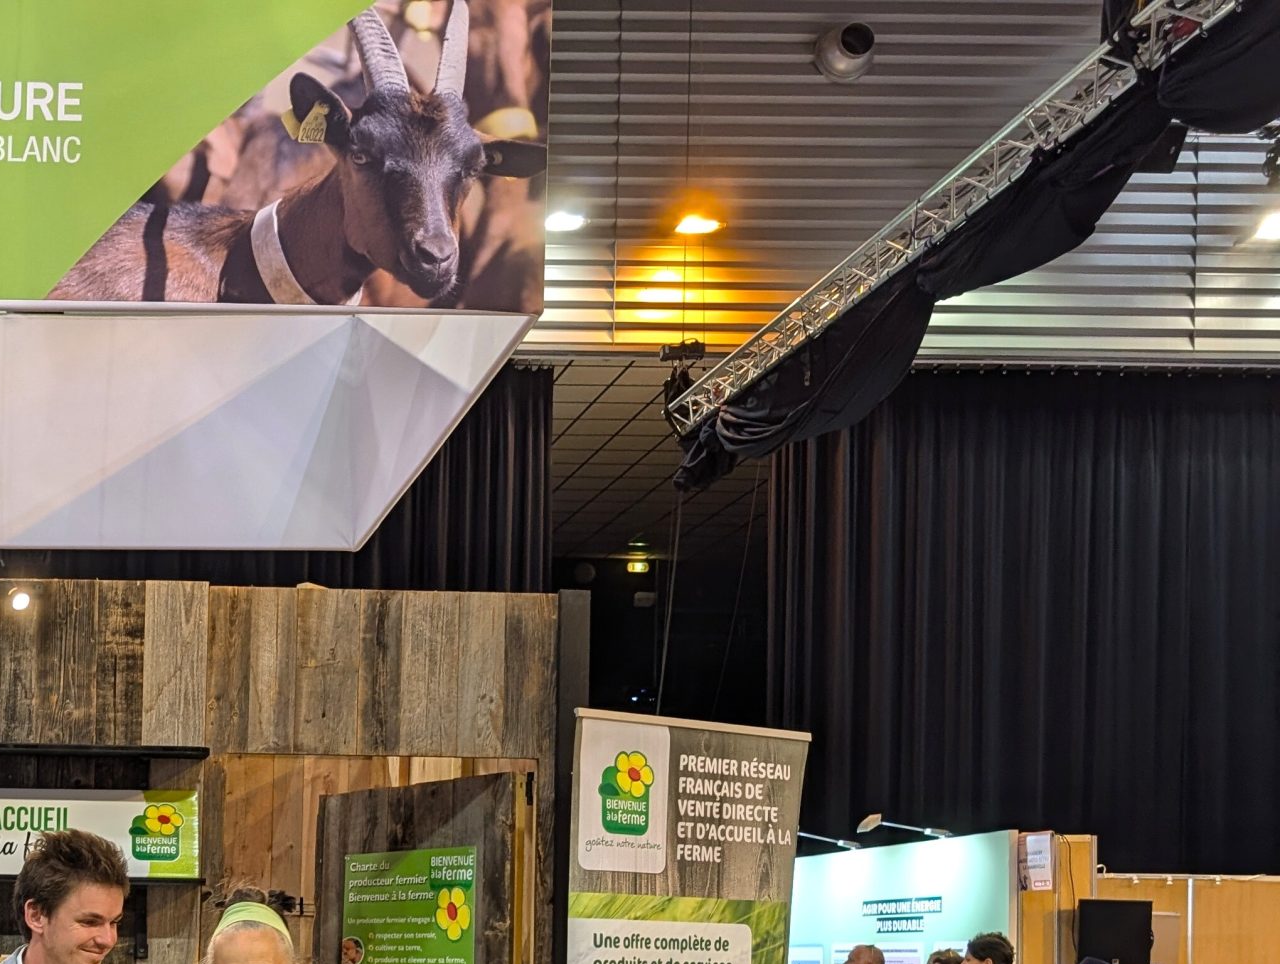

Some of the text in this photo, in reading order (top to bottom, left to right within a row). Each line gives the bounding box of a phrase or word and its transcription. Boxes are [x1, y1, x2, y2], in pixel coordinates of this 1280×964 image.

[679, 754, 791, 780] PREMIER RÉSEAU
[678, 777, 763, 801] FRANÇAIS DE
[607, 799, 646, 812] BIENVENUE
[678, 799, 778, 823] VENTE DIRECTE
[618, 812, 645, 825] ferme
[677, 822, 791, 845] ET D'ACCUEIL À LA
[136, 837, 177, 845] BIENVENUE
[585, 836, 662, 852] goûtez notre nature
[147, 844, 177, 855] ferme
[677, 844, 721, 863] FERME
[350, 861, 390, 872] Charte du
[431, 855, 474, 867] BIENVENUE
[442, 867, 473, 881] ferme
[349, 875, 428, 890] producteur fermier
[348, 891, 434, 903] Bienvenue à la ferme
[863, 898, 941, 914] AGIR POUR UNE ÉNERGIE
[877, 919, 923, 931] PLUS DURABLE
[593, 933, 729, 953] Une offre complète de
